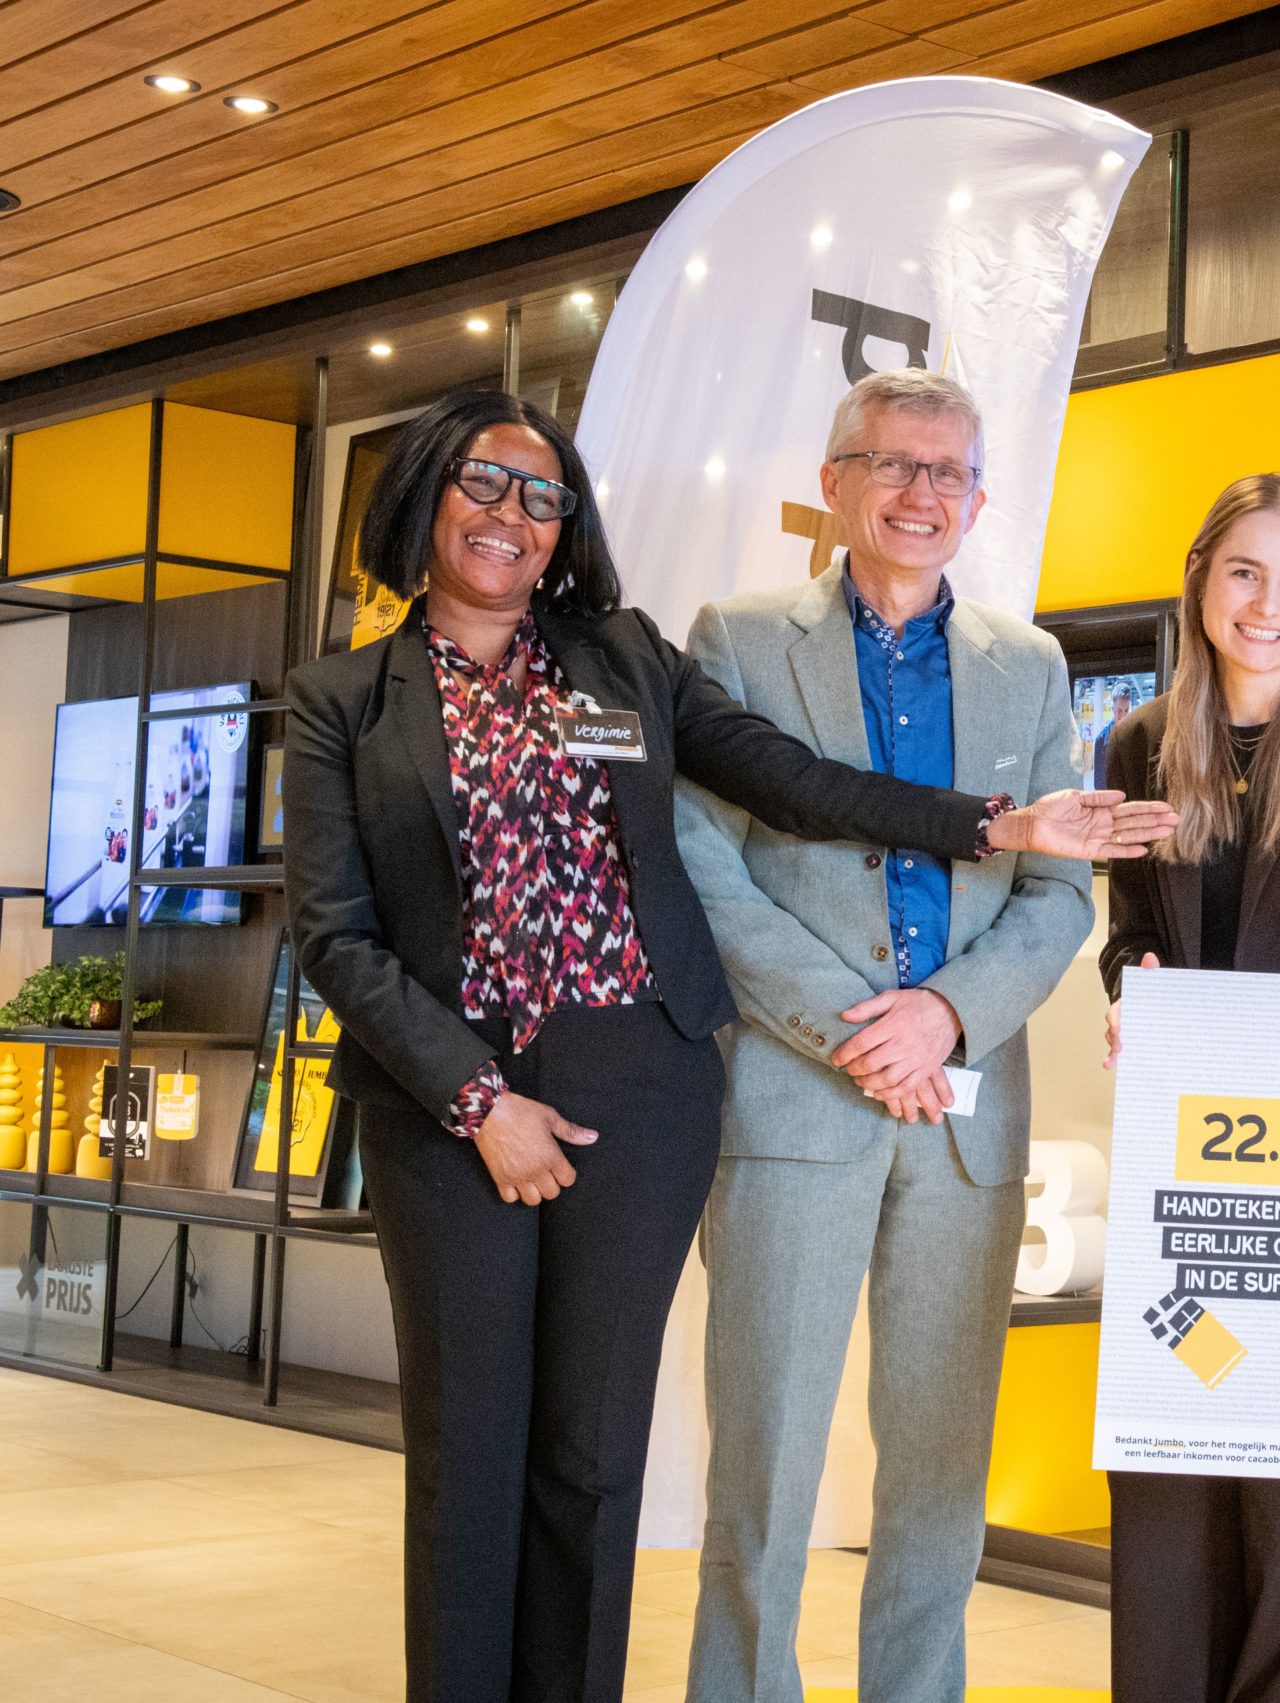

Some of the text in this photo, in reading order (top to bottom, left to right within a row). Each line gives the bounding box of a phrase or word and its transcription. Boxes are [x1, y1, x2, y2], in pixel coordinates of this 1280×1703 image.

[1171, 1232, 1268, 1256] EERLIJKE
[1184, 1269, 1205, 1289] IN
[1210, 1270, 1238, 1291] DE
[45, 1277, 93, 1315] PRIJS
[1115, 1436, 1152, 1445] Bedankt
[1154, 1437, 1186, 1448] Jumbo,
[1211, 1440, 1226, 1449] het
[1228, 1441, 1267, 1452] mogelijk
[1144, 1449, 1181, 1459] leefbaar
[1183, 1451, 1223, 1461] inkomen
